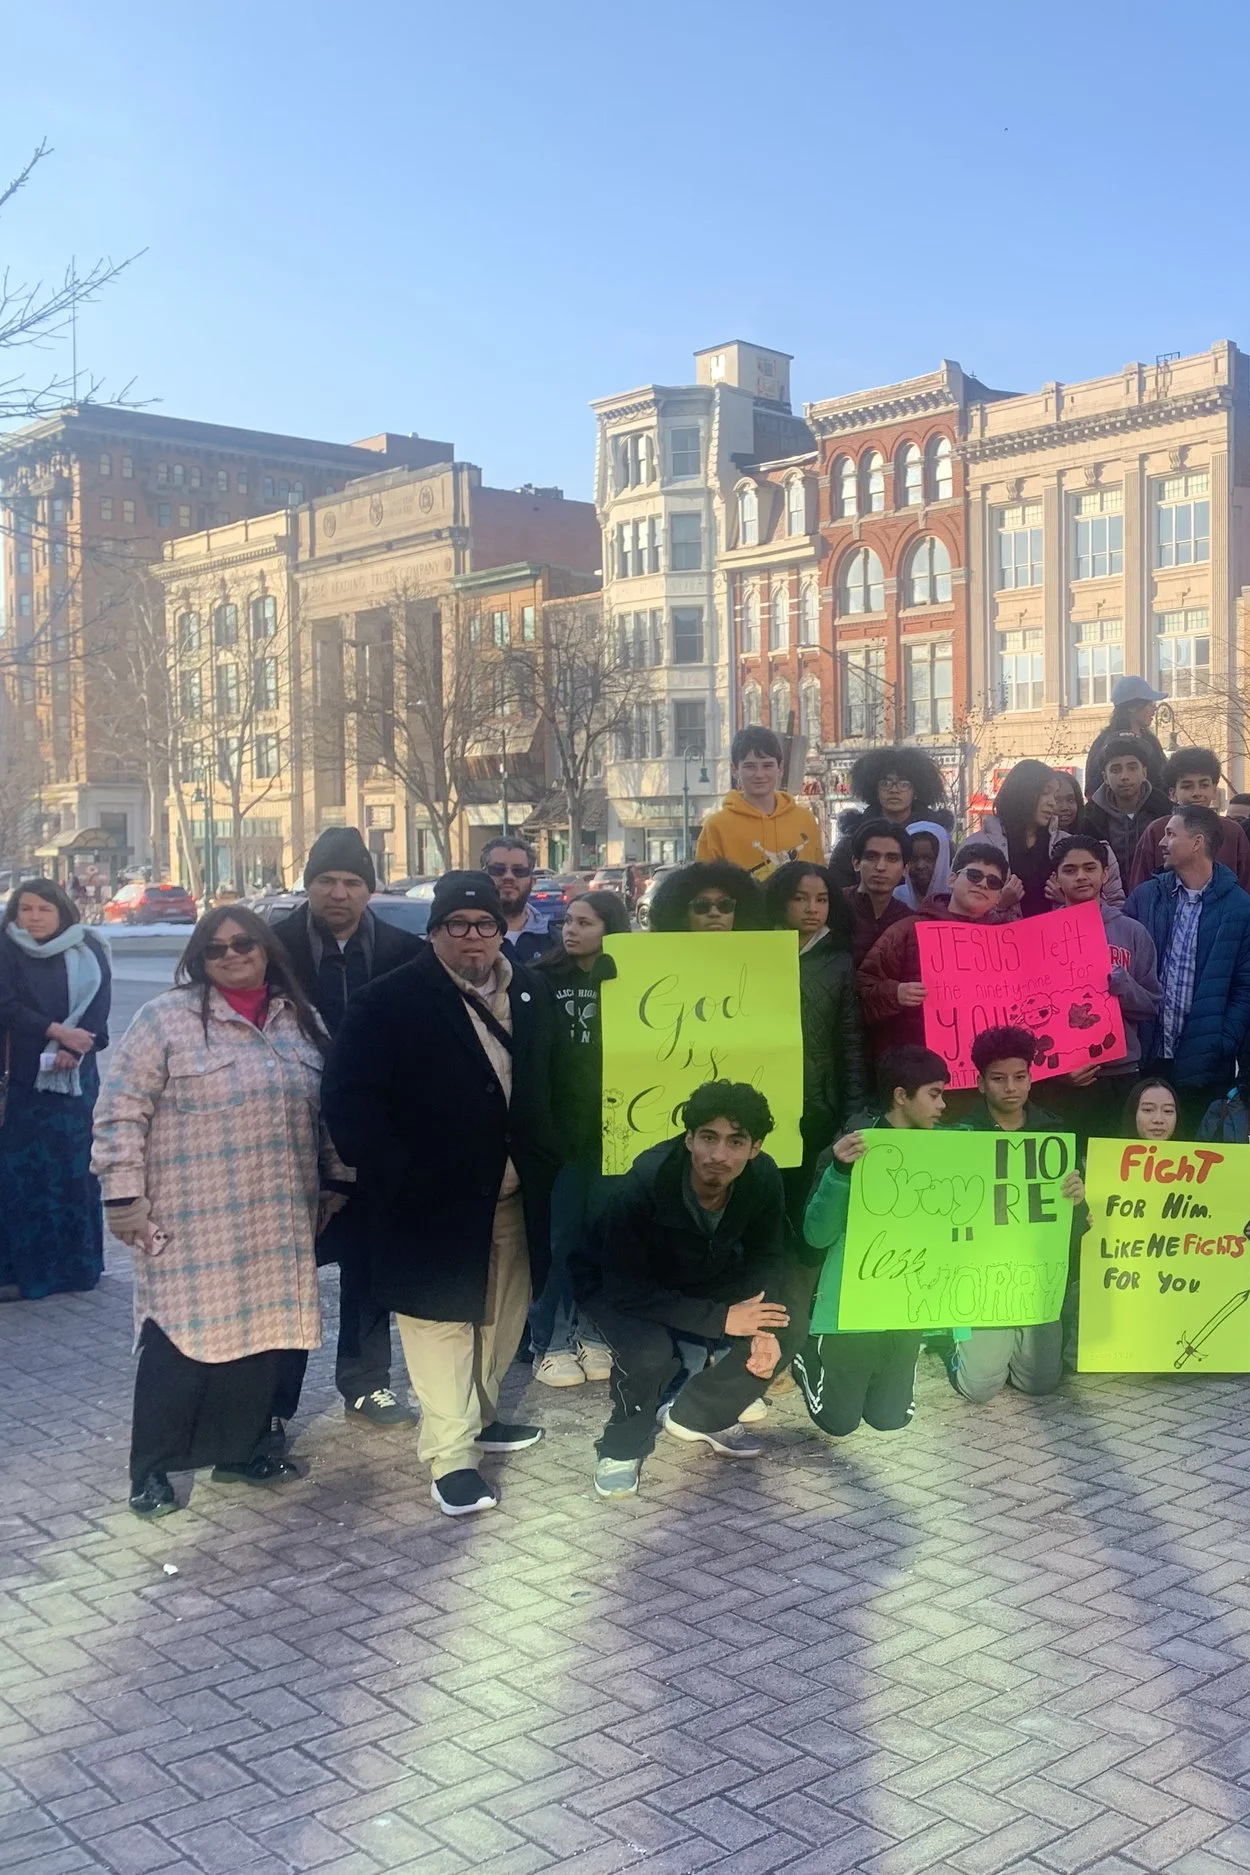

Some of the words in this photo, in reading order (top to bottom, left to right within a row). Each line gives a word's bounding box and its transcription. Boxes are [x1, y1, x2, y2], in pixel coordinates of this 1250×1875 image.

[927, 926, 1020, 973] JESUS
[1041, 919, 1088, 966] left
[933, 984, 960, 1000] the
[976, 973, 1052, 1002] ninety-nine
[1067, 961, 1094, 987] for
[638, 963, 750, 1062] God
[680, 1040, 728, 1081] is
[950, 1069, 977, 1088] ATT
[861, 1144, 985, 1226] Pray
[1106, 1195, 1147, 1218] FOR
[1147, 1233, 1180, 1257] HE
[904, 1261, 1068, 1323] WORRY
[1104, 1267, 1140, 1290] FOR
